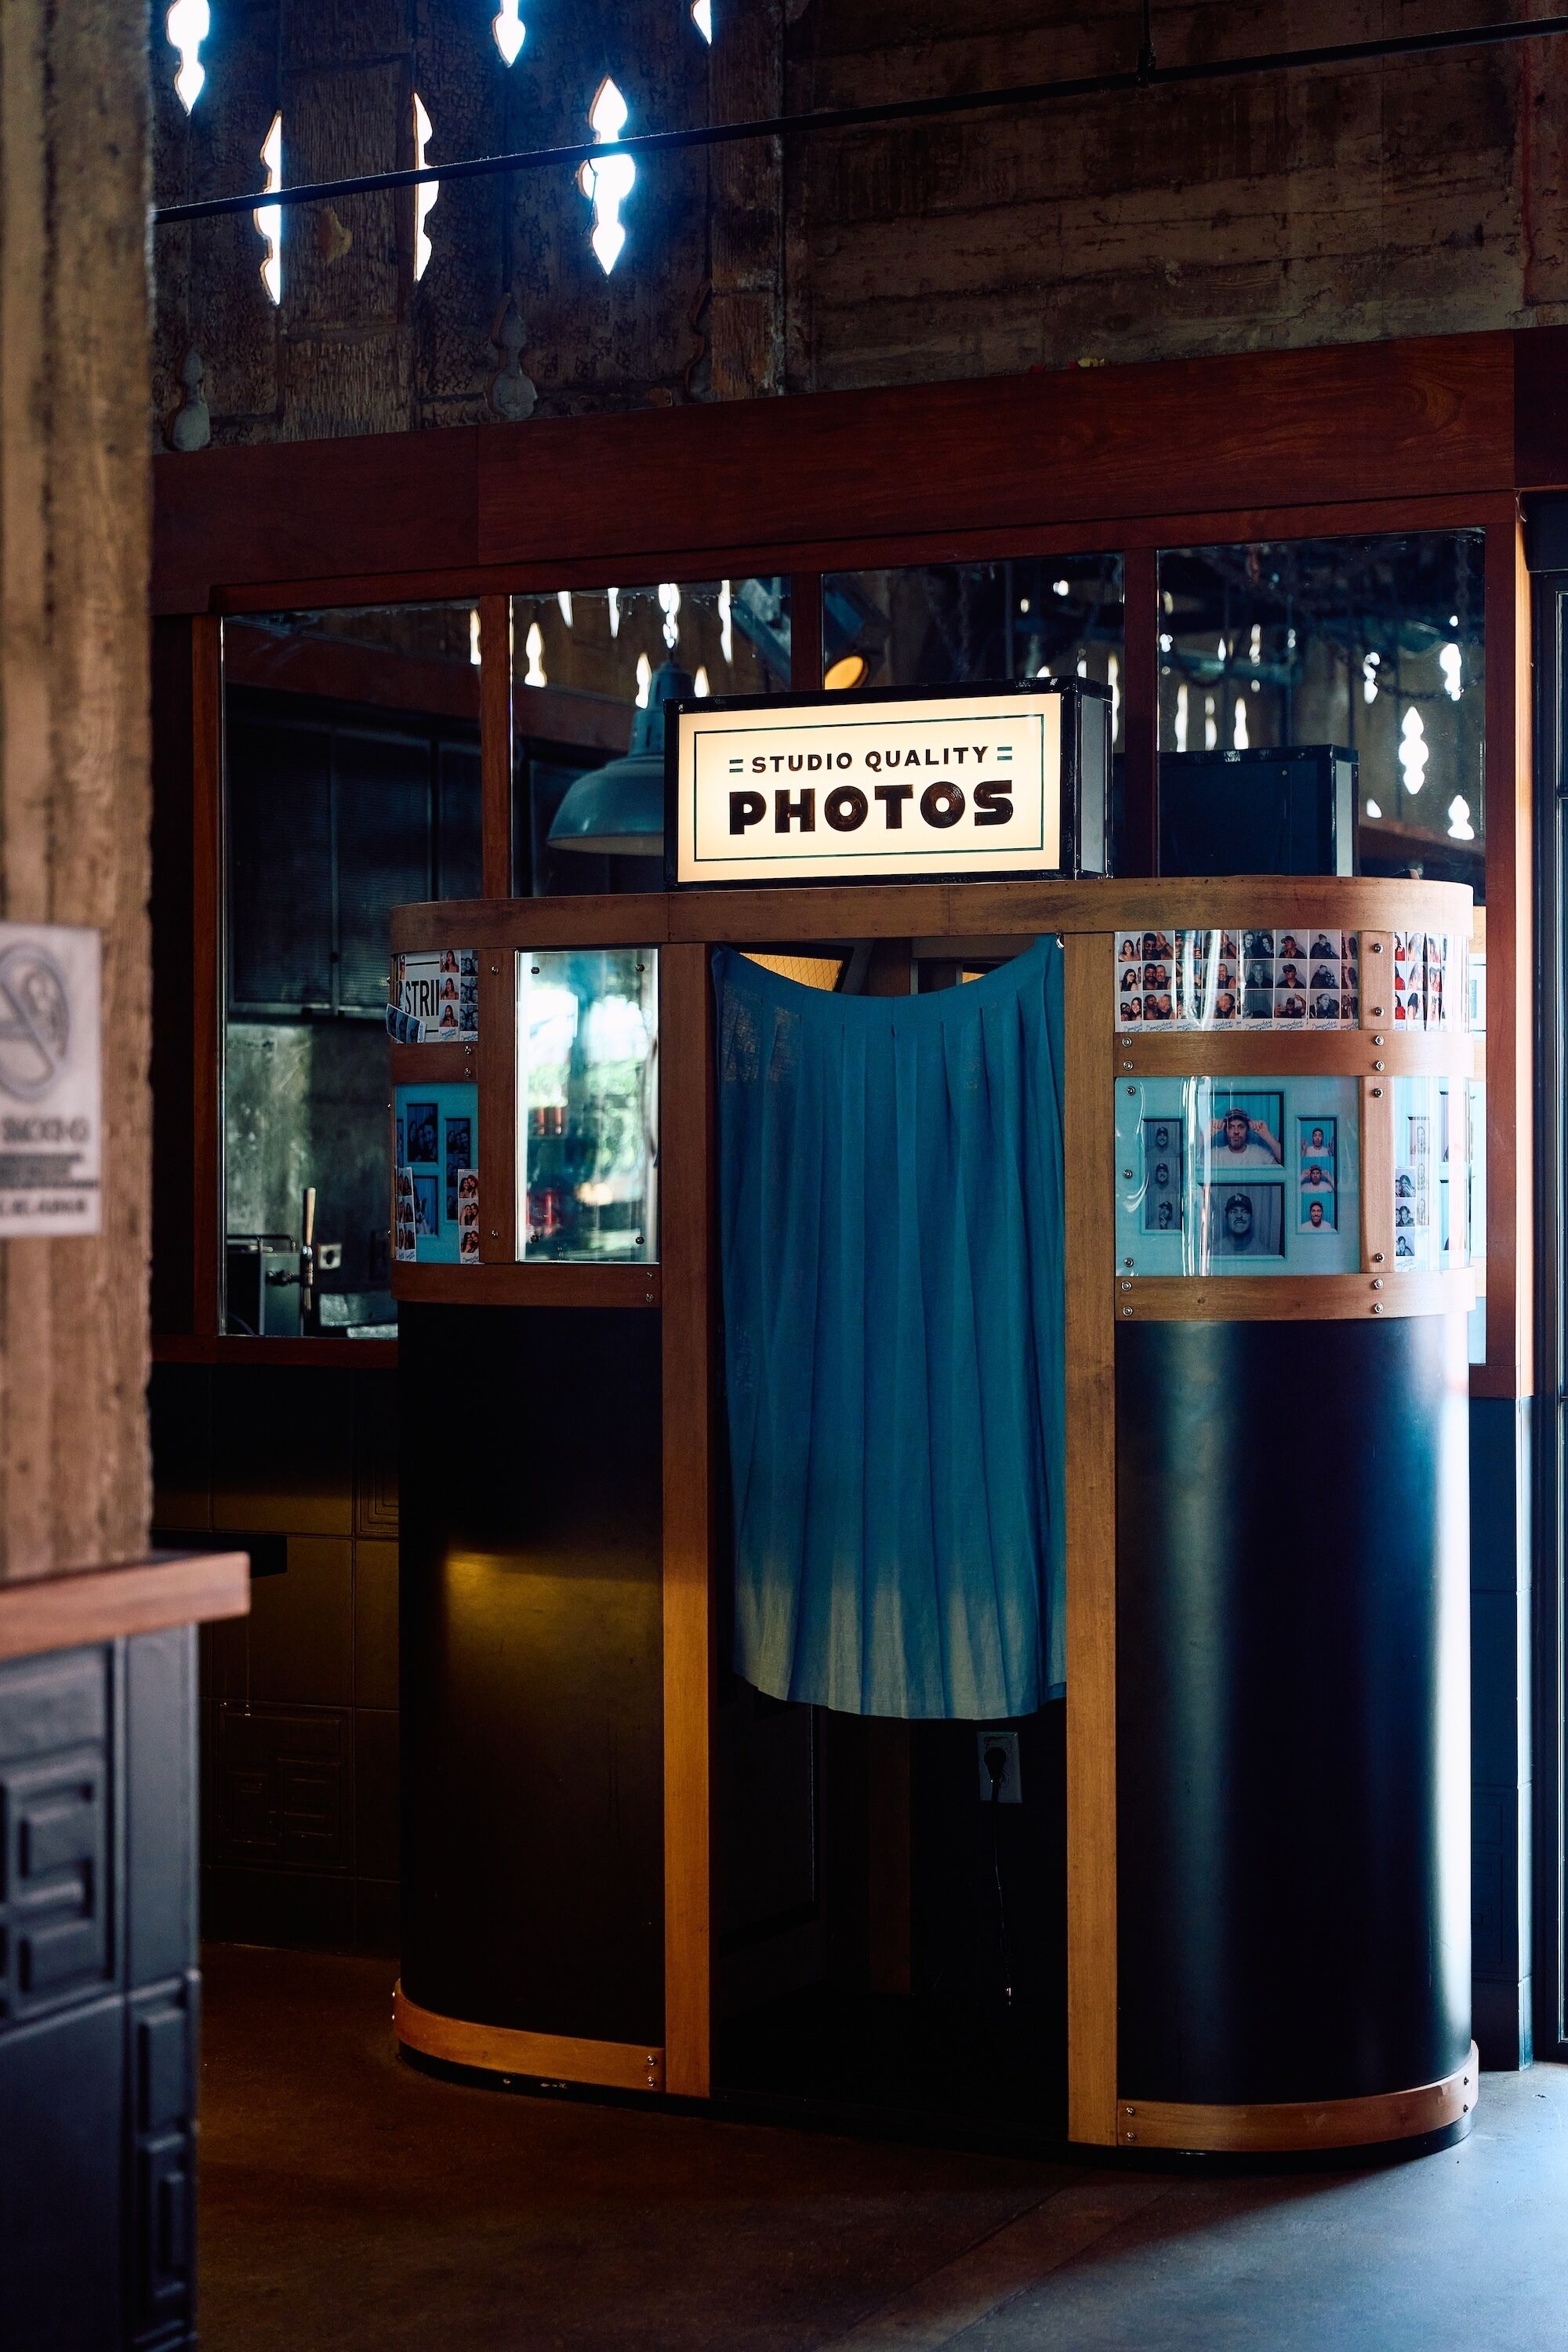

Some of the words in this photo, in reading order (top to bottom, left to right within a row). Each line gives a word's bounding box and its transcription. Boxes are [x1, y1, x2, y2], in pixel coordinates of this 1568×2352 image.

[751, 752, 853, 774] STUDIO
[865, 746, 989, 772] QUALITY
[729, 779, 1014, 836] PHOTOS
